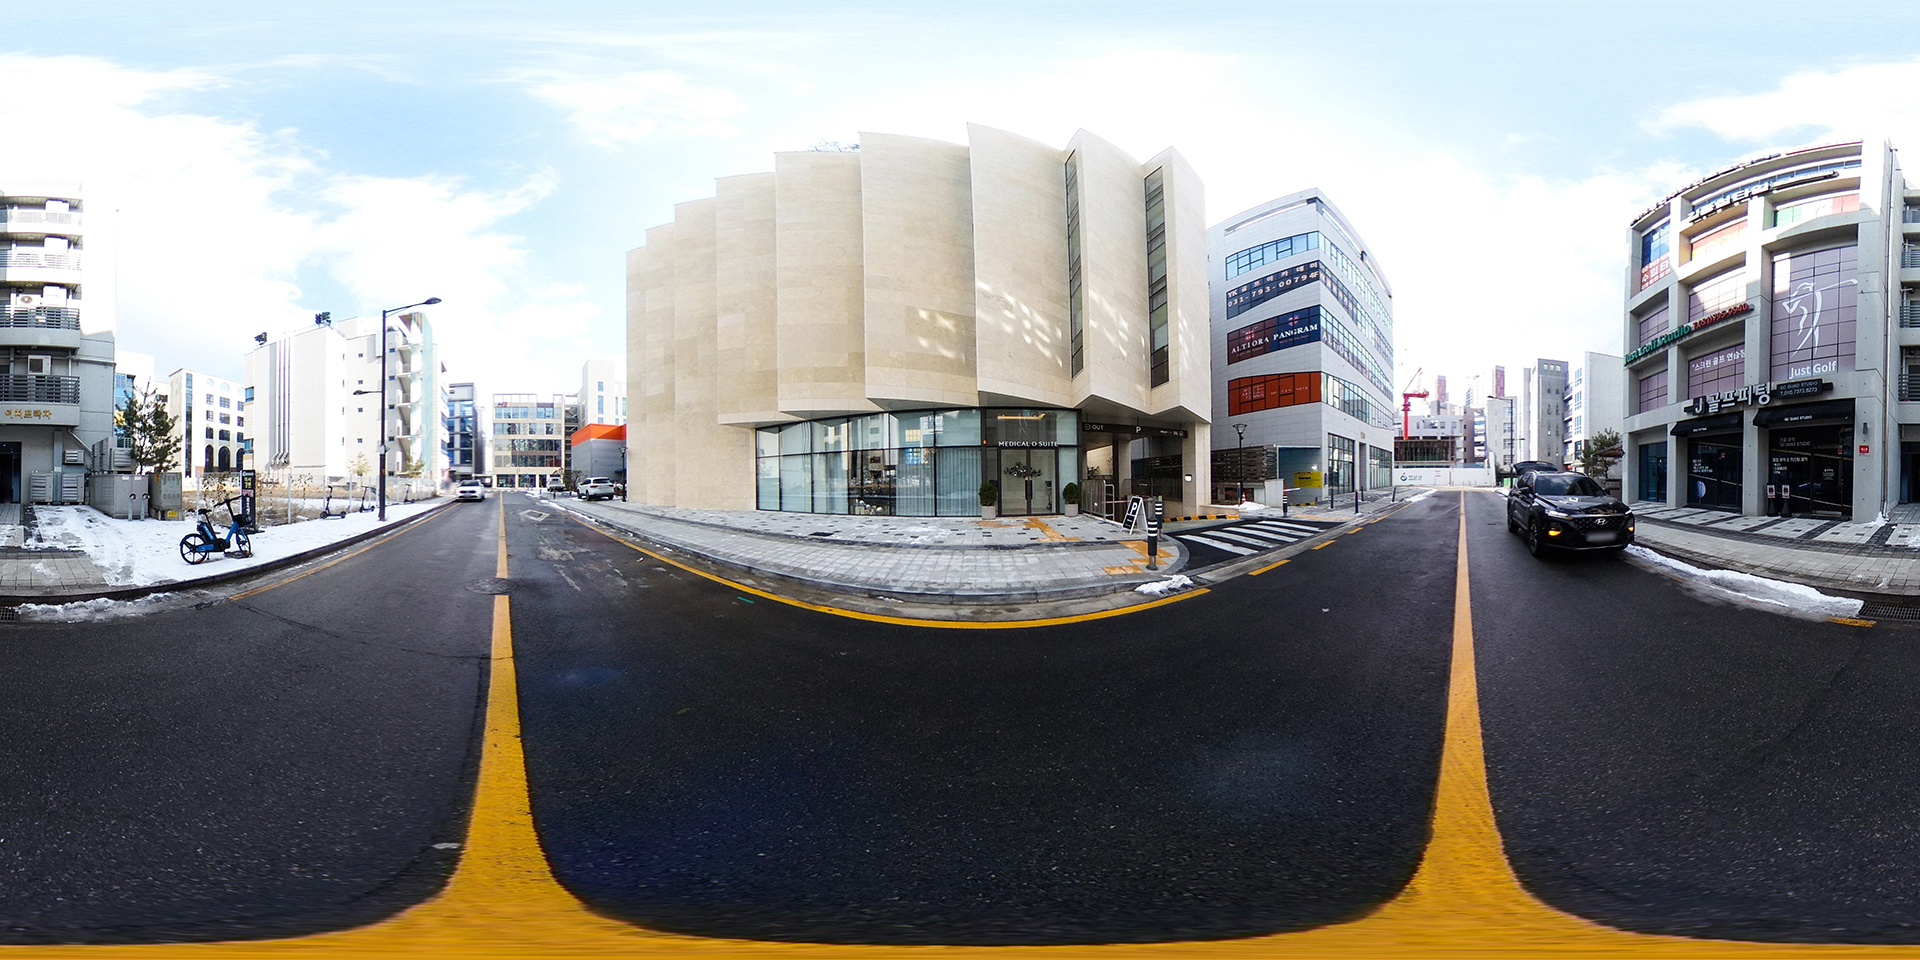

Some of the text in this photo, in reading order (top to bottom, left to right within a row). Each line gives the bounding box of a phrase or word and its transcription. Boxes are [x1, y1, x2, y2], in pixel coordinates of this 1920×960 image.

[1231, 336, 1270, 354] ALTIORA
[1272, 323, 1318, 341] PANGRAM
[1624, 349, 1640, 367] Just
[1640, 337, 1659, 356] Golf
[1659, 325, 1692, 346] Studio
[1713, 355, 1725, 366] 골프
[1789, 361, 1837, 380] Just Golf
[1707, 382, 1771, 413] 골프피팅
[1130, 502, 1137, 515] P
